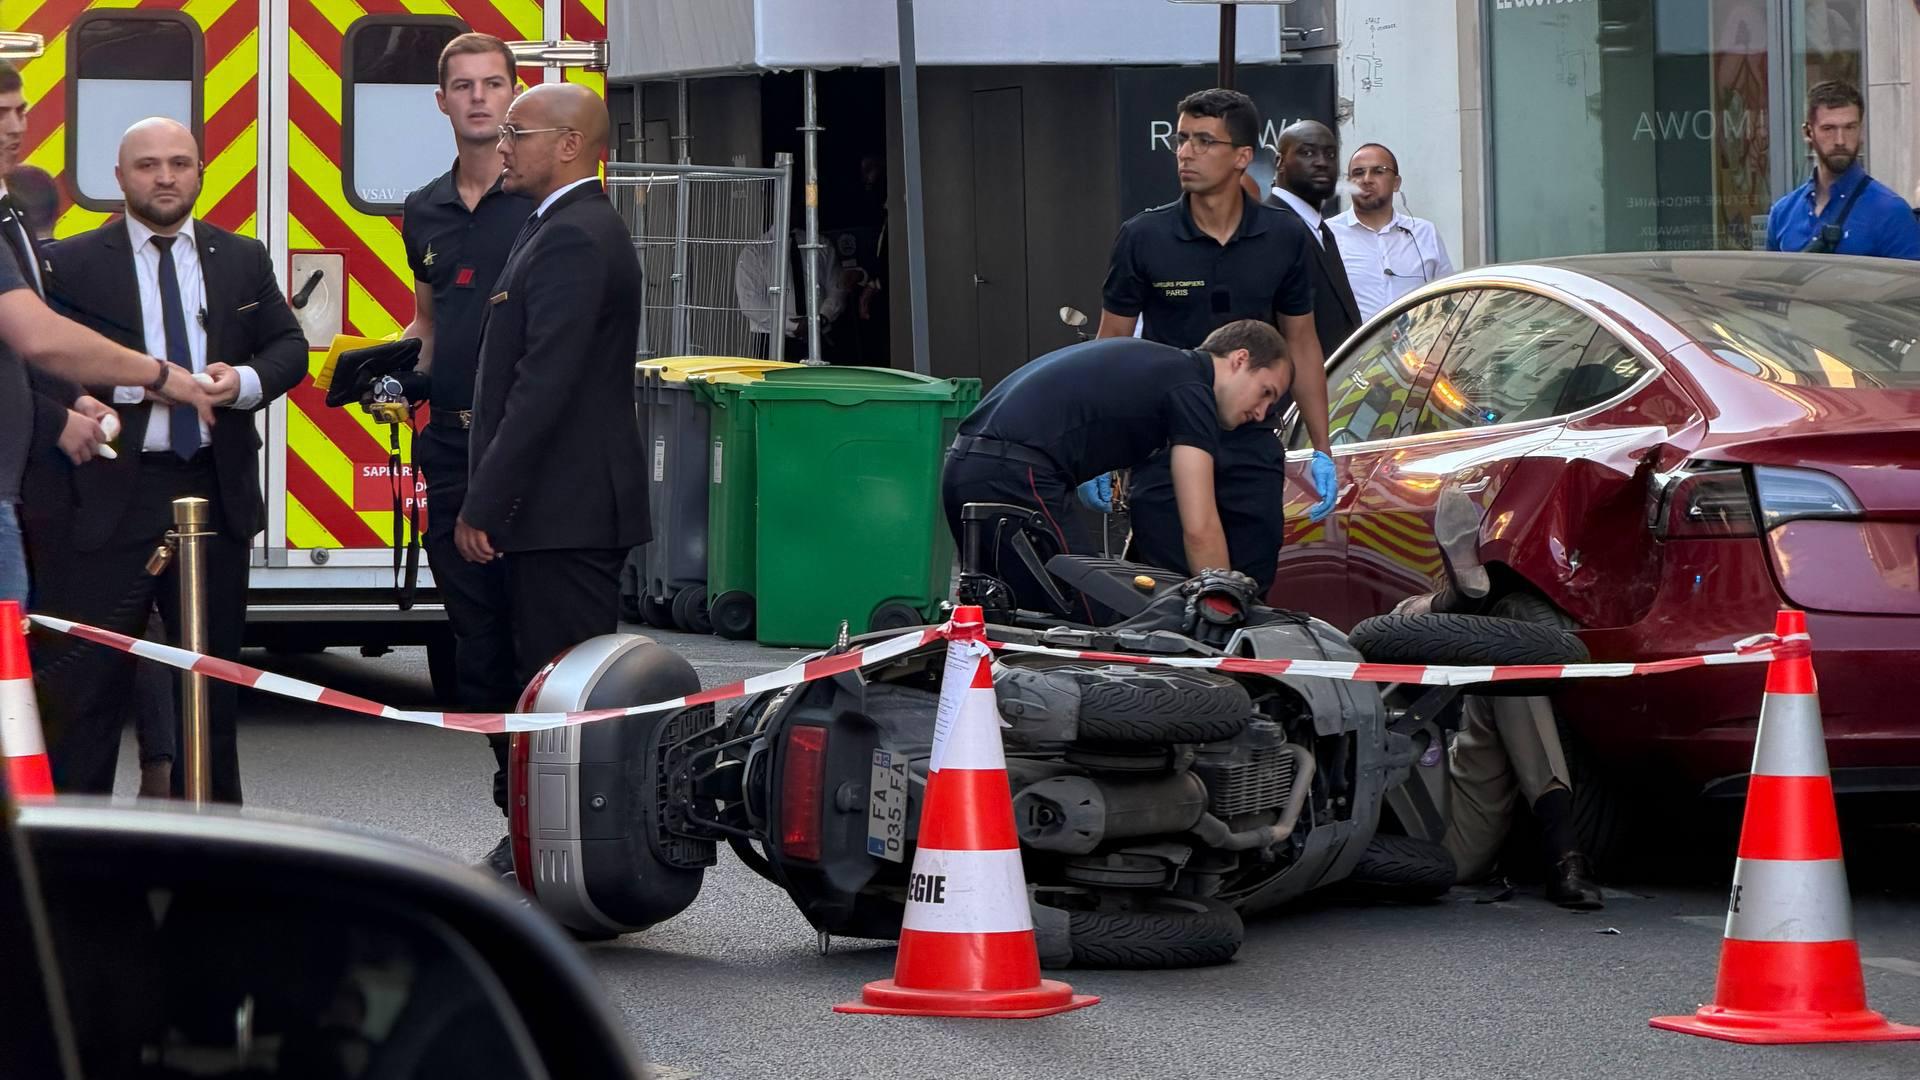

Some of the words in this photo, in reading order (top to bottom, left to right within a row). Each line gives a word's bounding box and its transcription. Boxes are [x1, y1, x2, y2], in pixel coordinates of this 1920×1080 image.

[361, 188, 396, 200] VSAV
[887, 764, 904, 852] 035-FA
[909, 873, 946, 904] EGIE
